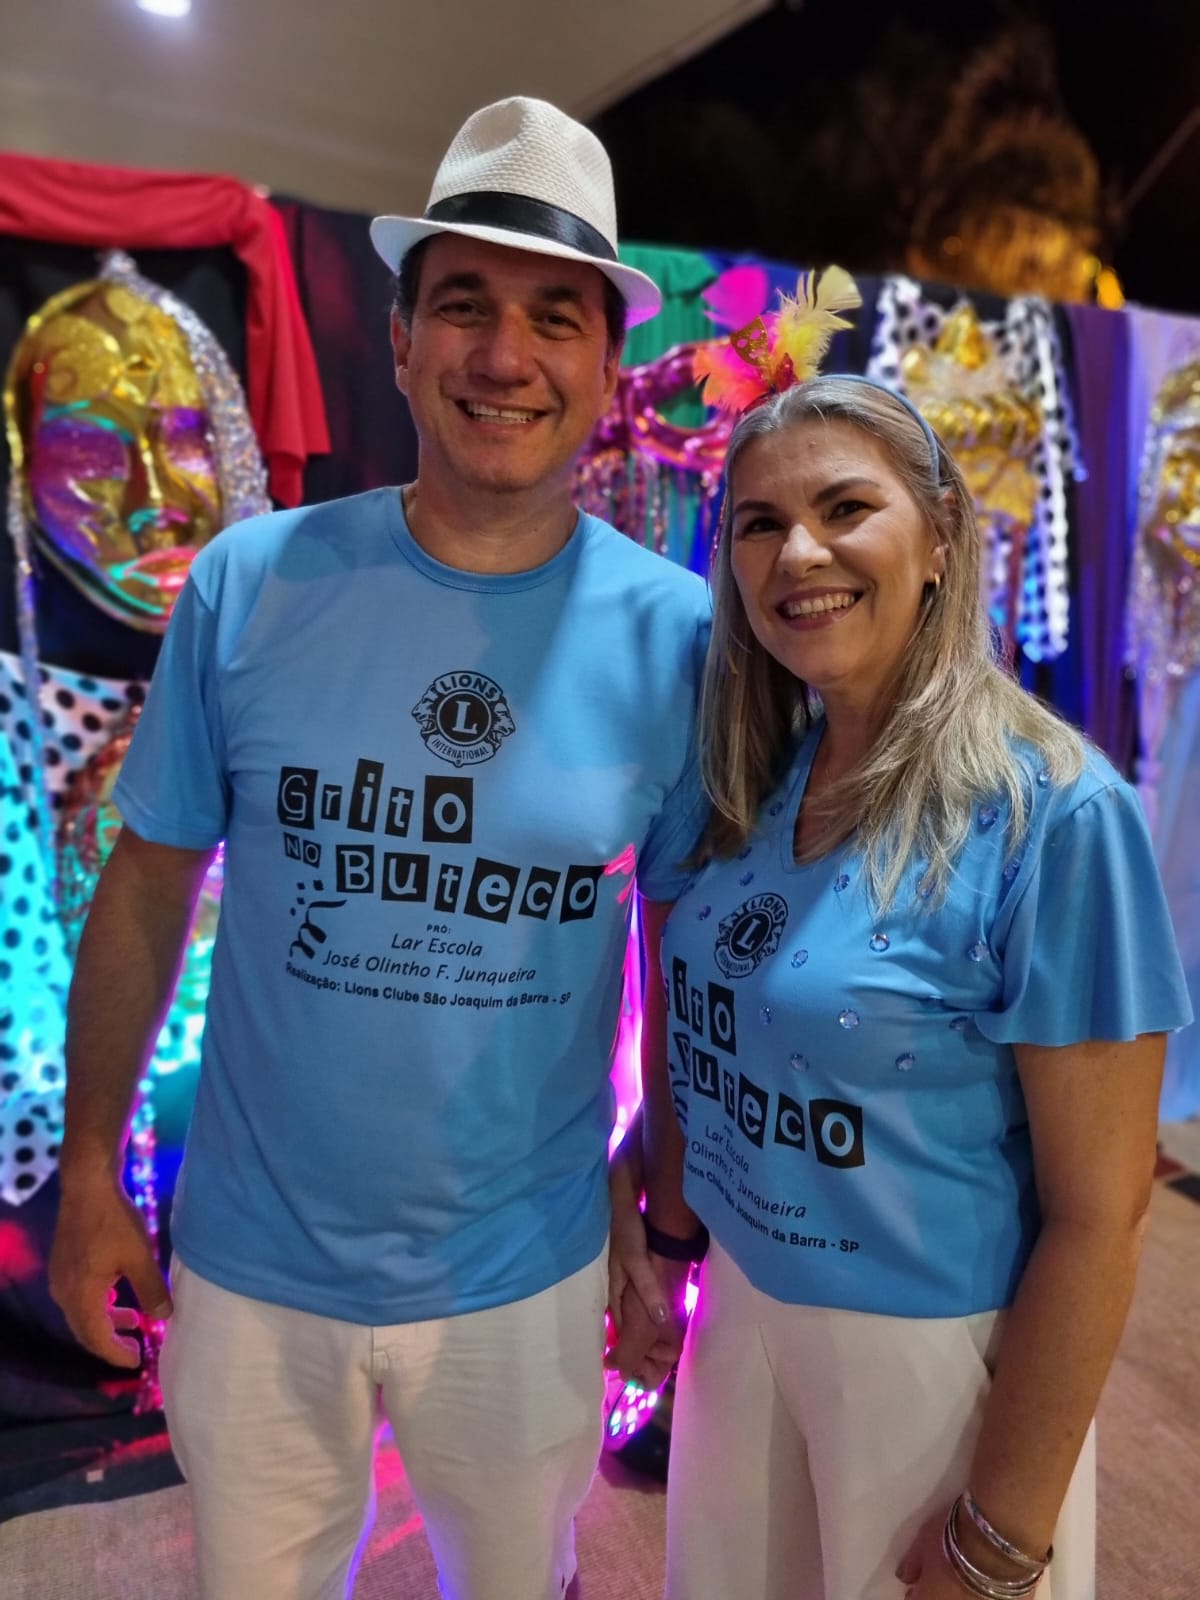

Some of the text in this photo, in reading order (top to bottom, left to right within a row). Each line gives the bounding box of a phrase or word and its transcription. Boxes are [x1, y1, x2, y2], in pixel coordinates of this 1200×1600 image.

[440, 674, 498, 700] LIONS
[452, 700, 478, 735] L
[431, 738, 490, 761] INTERNATIONAL
[280, 767, 470, 837] Grito
[284, 834, 320, 866] NO
[338, 846, 598, 919] Buteco
[751, 896, 786, 920] LIONS
[391, 933, 483, 957] Lar Escola
[737, 918, 761, 951] L
[322, 950, 536, 986] José Olintho F. Junqueira
[345, 981, 379, 998] Lions
[383, 986, 420, 1003] Clube
[423, 991, 447, 1006] São
[450, 993, 503, 1010] Joaquim
[506, 996, 518, 1008] da
[520, 992, 549, 1006] Barra
[560, 991, 572, 1005] SP
[705, 1124, 723, 1146] Lar
[737, 1179, 807, 1219] Junqueira
[772, 1228, 786, 1243] da
[789, 1232, 826, 1249] Barra
[840, 1239, 860, 1253] SP
